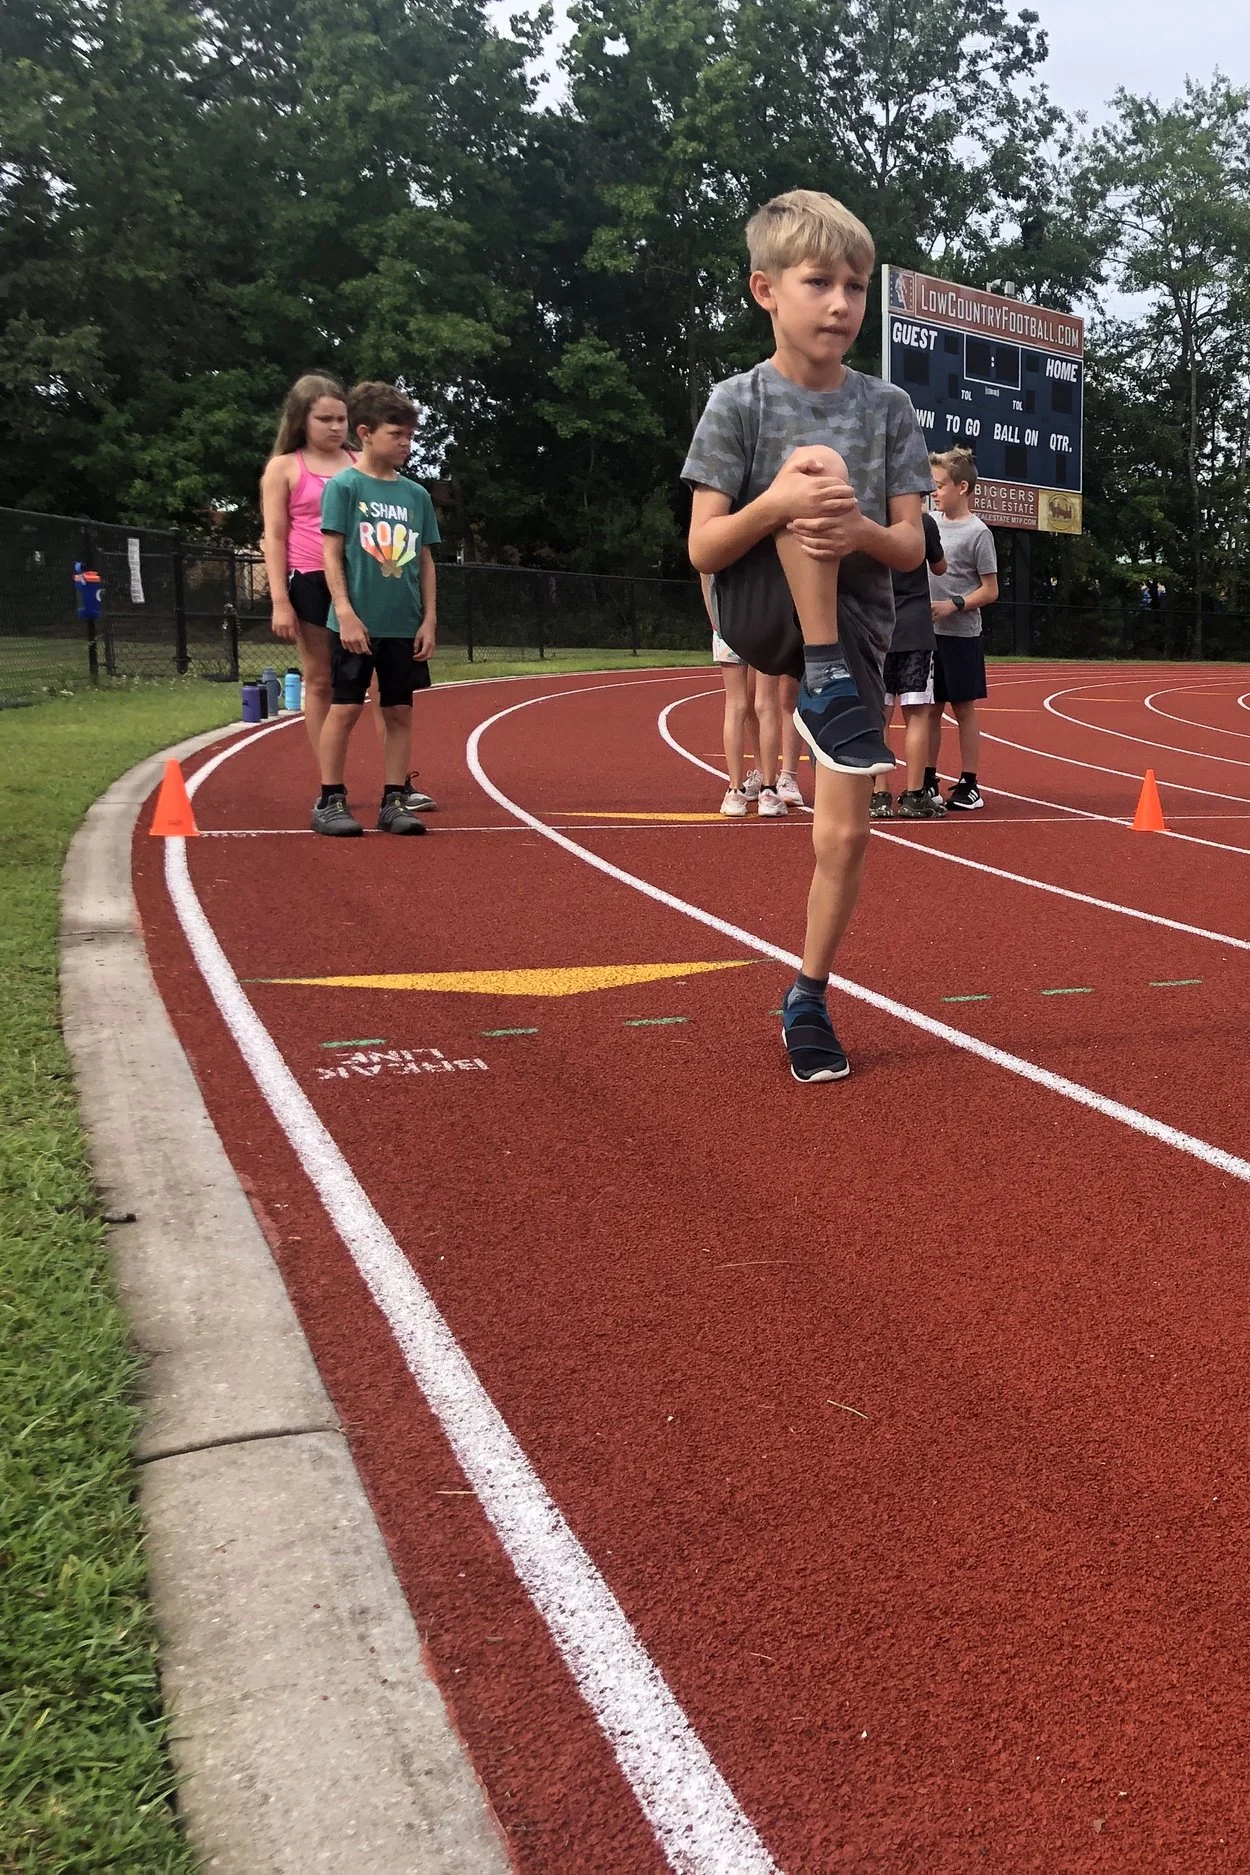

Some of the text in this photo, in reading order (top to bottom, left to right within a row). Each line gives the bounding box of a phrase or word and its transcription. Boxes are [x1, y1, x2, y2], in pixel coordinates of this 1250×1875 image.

[892, 322, 938, 350] GUEST
[1045, 358, 1078, 382] HOME
[960, 389, 973, 401] TOL
[1012, 400, 1023, 411] TOL
[916, 408, 981, 437] WN TO GO
[993, 423, 1039, 447] BALL ON
[1050, 433, 1073, 453] QTR.
[974, 484, 1034, 502] BIGGERS
[370, 501, 408, 522] SHAM
[974, 497, 1034, 515] REAL ESTATE
[359, 520, 420, 568] ROCK
[335, 1048, 444, 1065] LINE
[313, 1057, 490, 1080] BREAK
